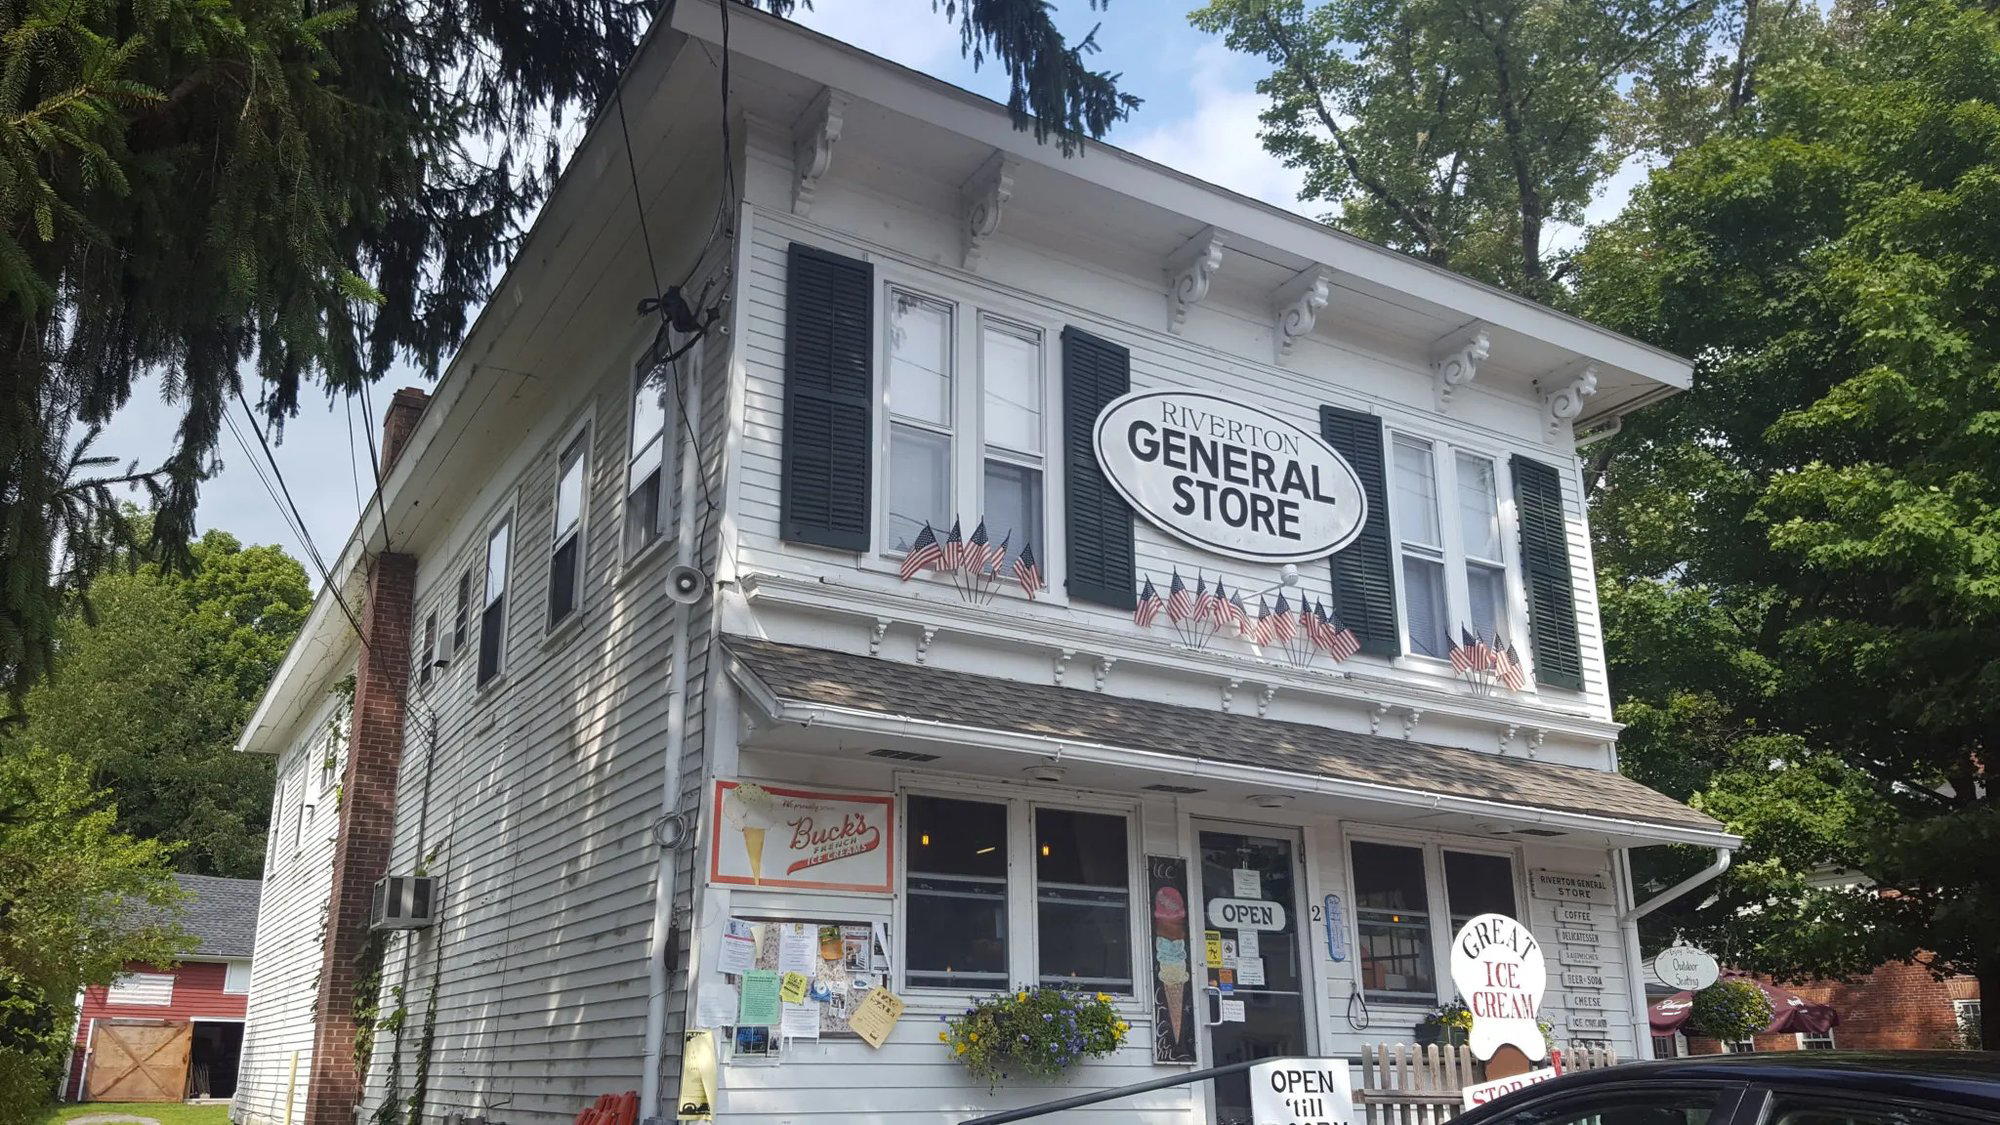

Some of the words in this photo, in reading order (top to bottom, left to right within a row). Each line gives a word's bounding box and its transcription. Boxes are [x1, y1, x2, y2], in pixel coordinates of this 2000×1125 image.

[1161, 401, 1299, 456] RIVERTON
[1127, 420, 1335, 505] GENERAL
[1172, 475, 1302, 541] STORE
[787, 812, 867, 850] Buck's
[1540, 875, 1575, 886] RIVERTON
[1577, 879, 1606, 890] GENERAL
[1558, 887, 1592, 899] STORE
[1222, 903, 1273, 925] OPEN
[1311, 905, 1321, 921] 2
[1564, 910, 1591, 921] COFFEE
[1462, 919, 1536, 960] GREAT
[1562, 931, 1599, 943] DELICATESSEN
[1672, 958, 1697, 971] Outdoor
[1483, 961, 1520, 989] ICE
[1567, 974, 1583, 985] BEER
[1676, 973, 1699, 990] Seating
[1473, 991, 1534, 1019] CREAM
[1574, 996, 1601, 1007] CHEESE
[1271, 1070, 1334, 1093] OPEN
[1285, 1098, 1323, 1117] 'till
